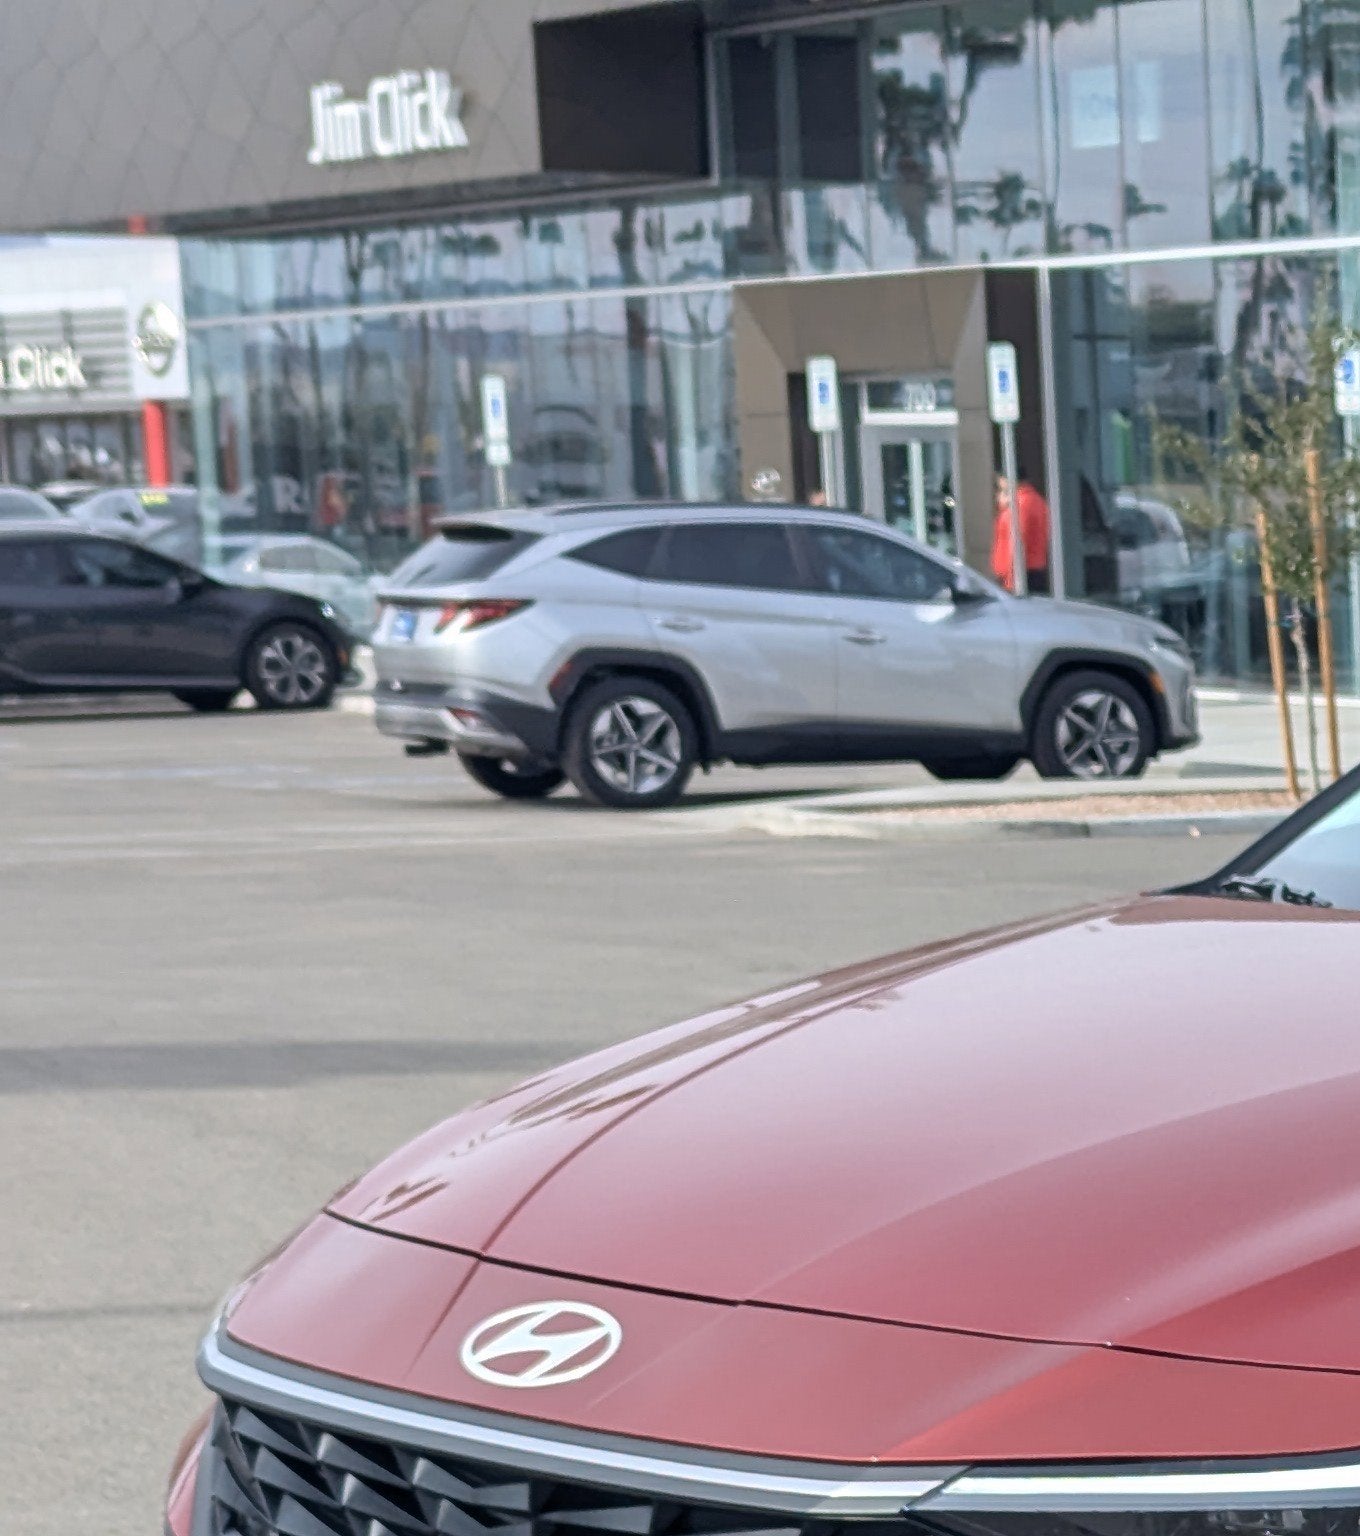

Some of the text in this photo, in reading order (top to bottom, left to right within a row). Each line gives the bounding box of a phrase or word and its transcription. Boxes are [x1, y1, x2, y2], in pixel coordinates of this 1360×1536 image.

[307, 68, 468, 165] Jim Click
[8, 343, 88, 391] Click
